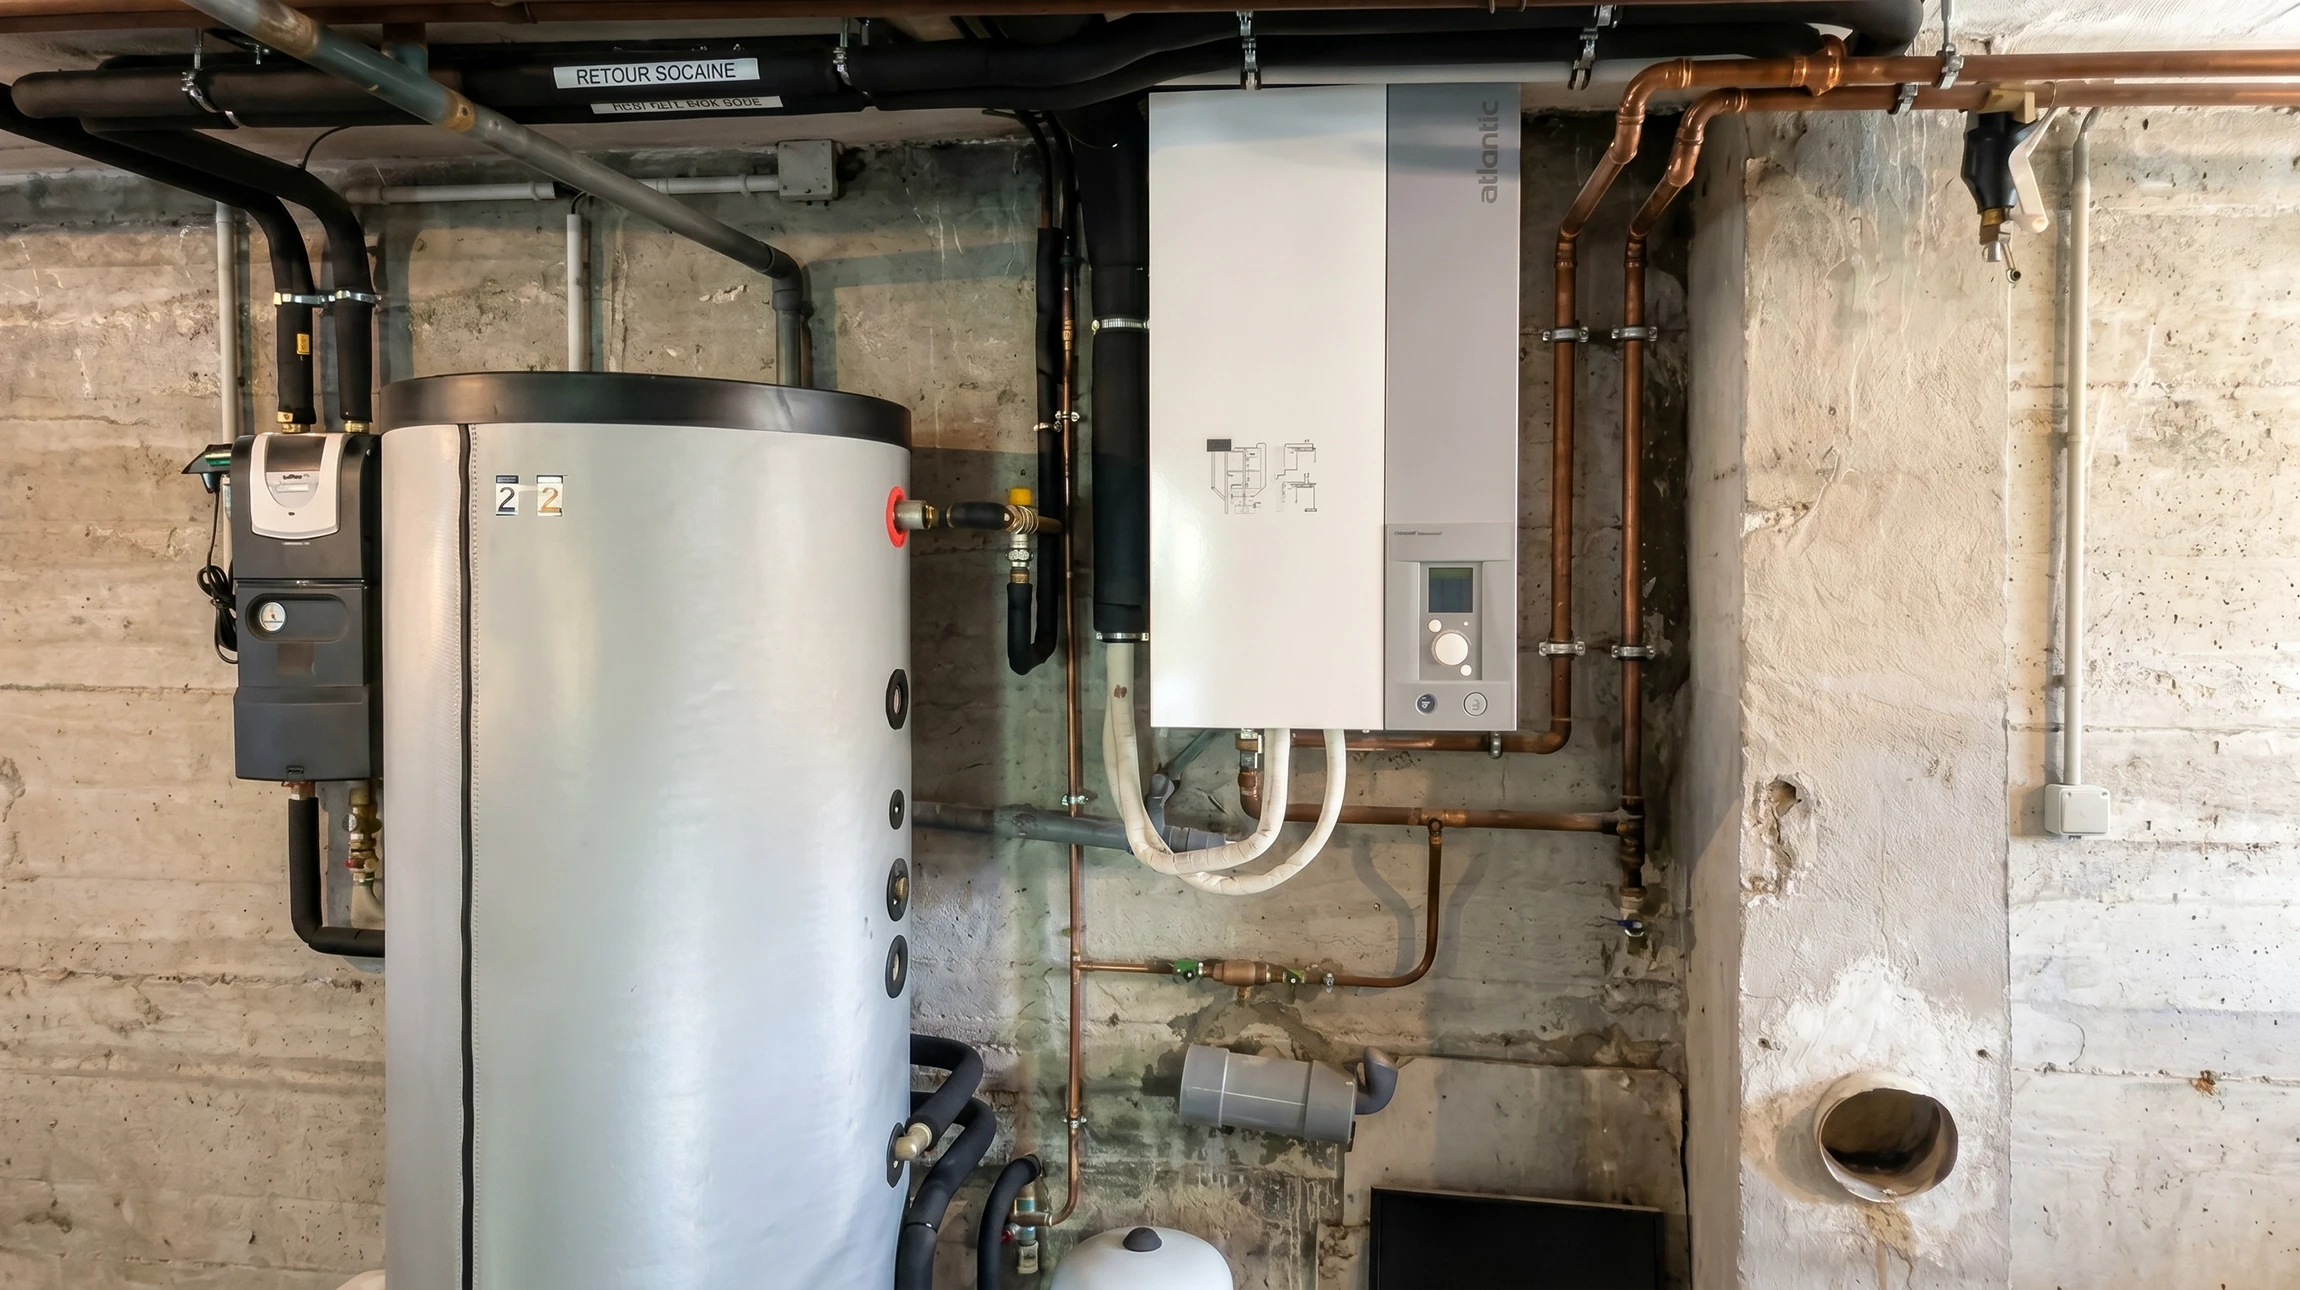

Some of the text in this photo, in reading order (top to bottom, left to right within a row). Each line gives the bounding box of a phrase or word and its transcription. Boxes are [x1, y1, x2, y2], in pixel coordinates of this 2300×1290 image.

[576, 62, 736, 85] RETOUR SOCAINE
[1476, 101, 1499, 204] atlantic
[498, 487, 559, 513] 2 2
